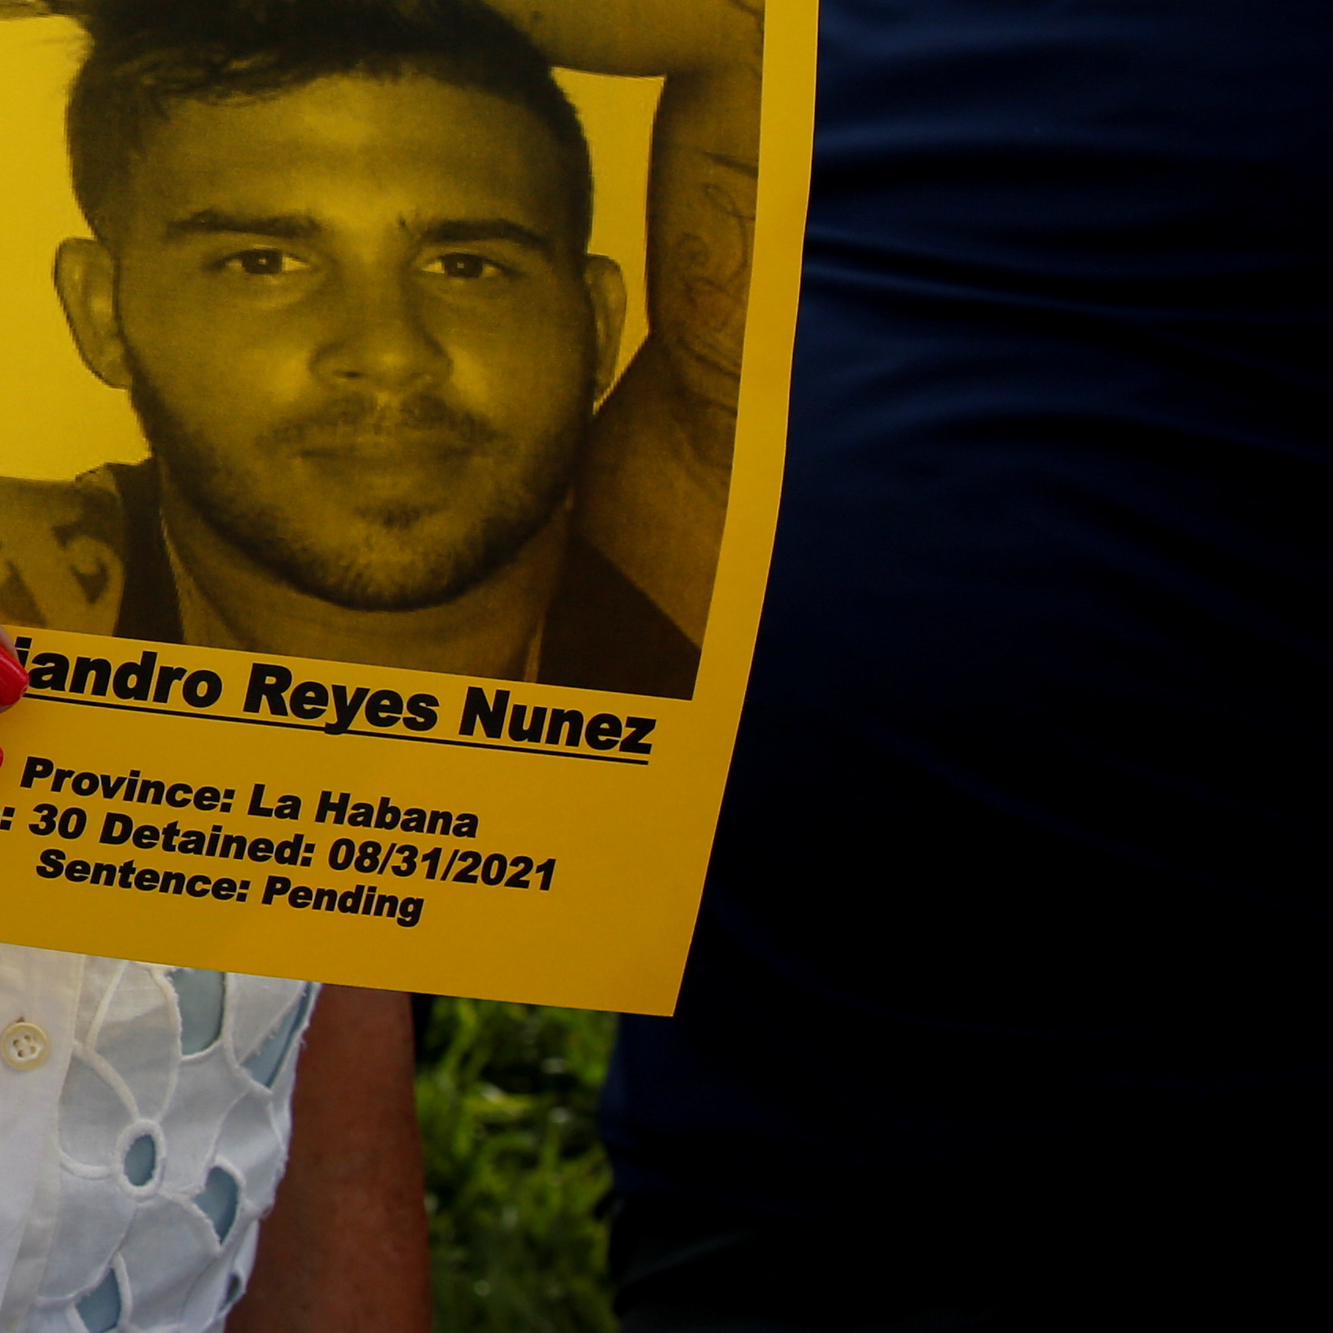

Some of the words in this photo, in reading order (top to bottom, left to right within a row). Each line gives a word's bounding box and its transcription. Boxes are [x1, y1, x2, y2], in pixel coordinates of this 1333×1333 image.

[242, 661, 441, 736] Reyes
[458, 685, 658, 756] Nunez
[20, 755, 236, 813] Province:
[247, 783, 303, 821] La
[314, 790, 480, 839] Habana
[28, 802, 87, 840] 30
[99, 812, 317, 868] Detained:
[327, 837, 557, 892] 08/31/2021
[35, 847, 251, 903] Sentence:
[261, 874, 425, 928] Pending
